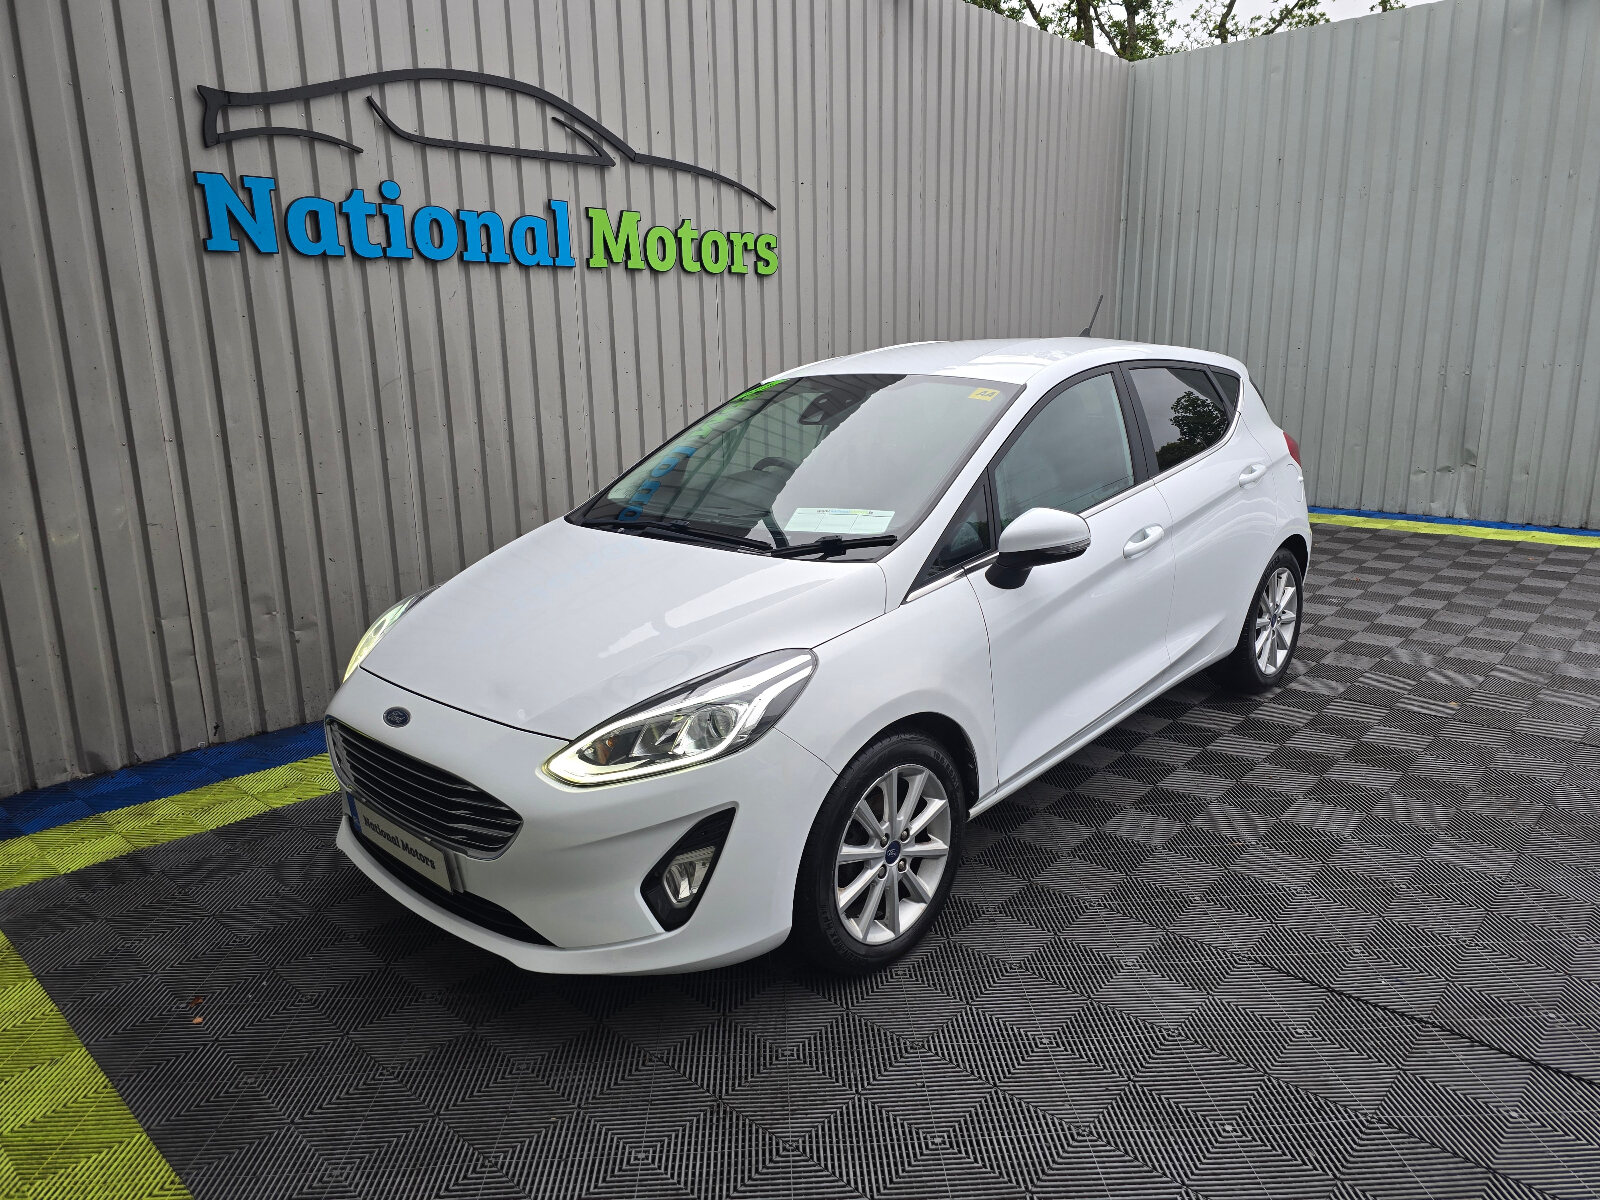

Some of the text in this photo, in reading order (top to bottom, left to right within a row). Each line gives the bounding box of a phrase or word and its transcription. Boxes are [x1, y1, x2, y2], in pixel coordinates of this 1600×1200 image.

[193, 170, 779, 277] National Motors
[362, 814, 401, 848] National
[400, 839, 436, 870] Motors
